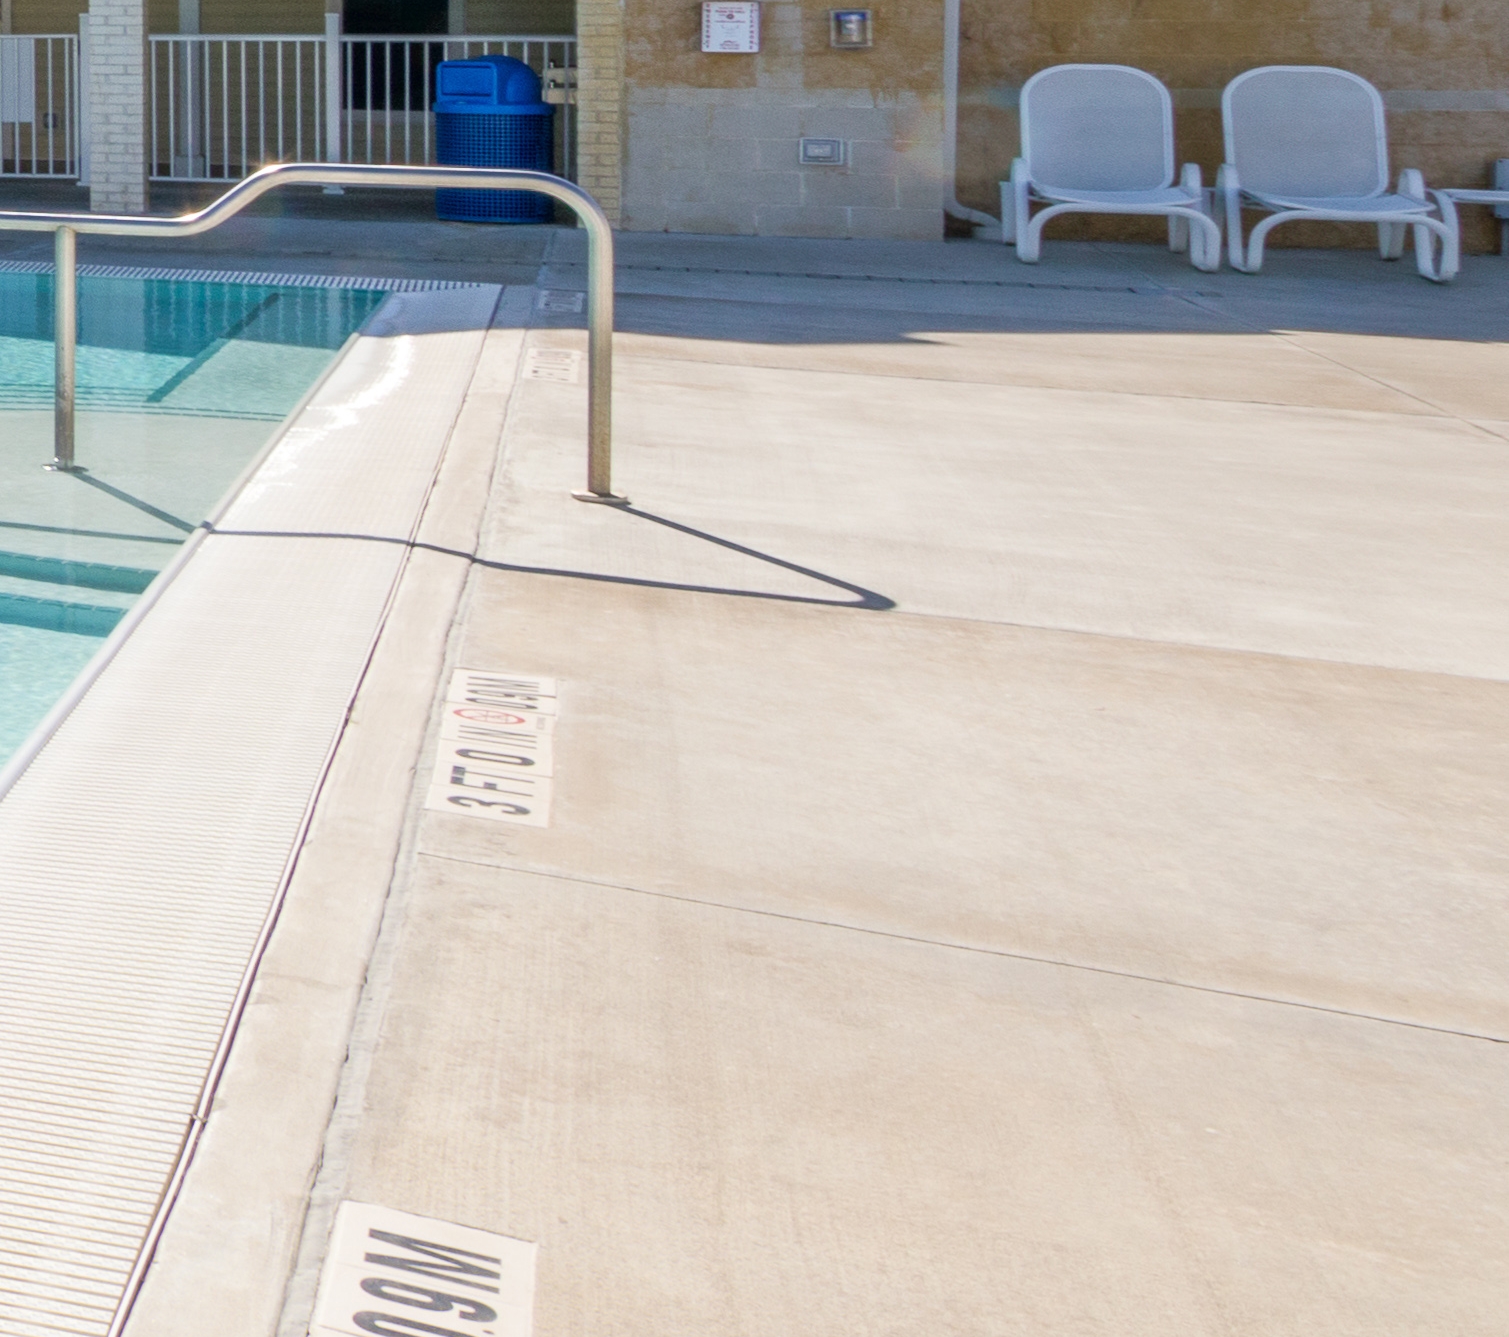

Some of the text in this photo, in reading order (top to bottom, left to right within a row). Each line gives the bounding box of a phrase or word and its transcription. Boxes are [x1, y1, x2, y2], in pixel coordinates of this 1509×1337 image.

[457, 724, 538, 750] IN
[450, 765, 536, 798] FT
[446, 795, 532, 816] 3
